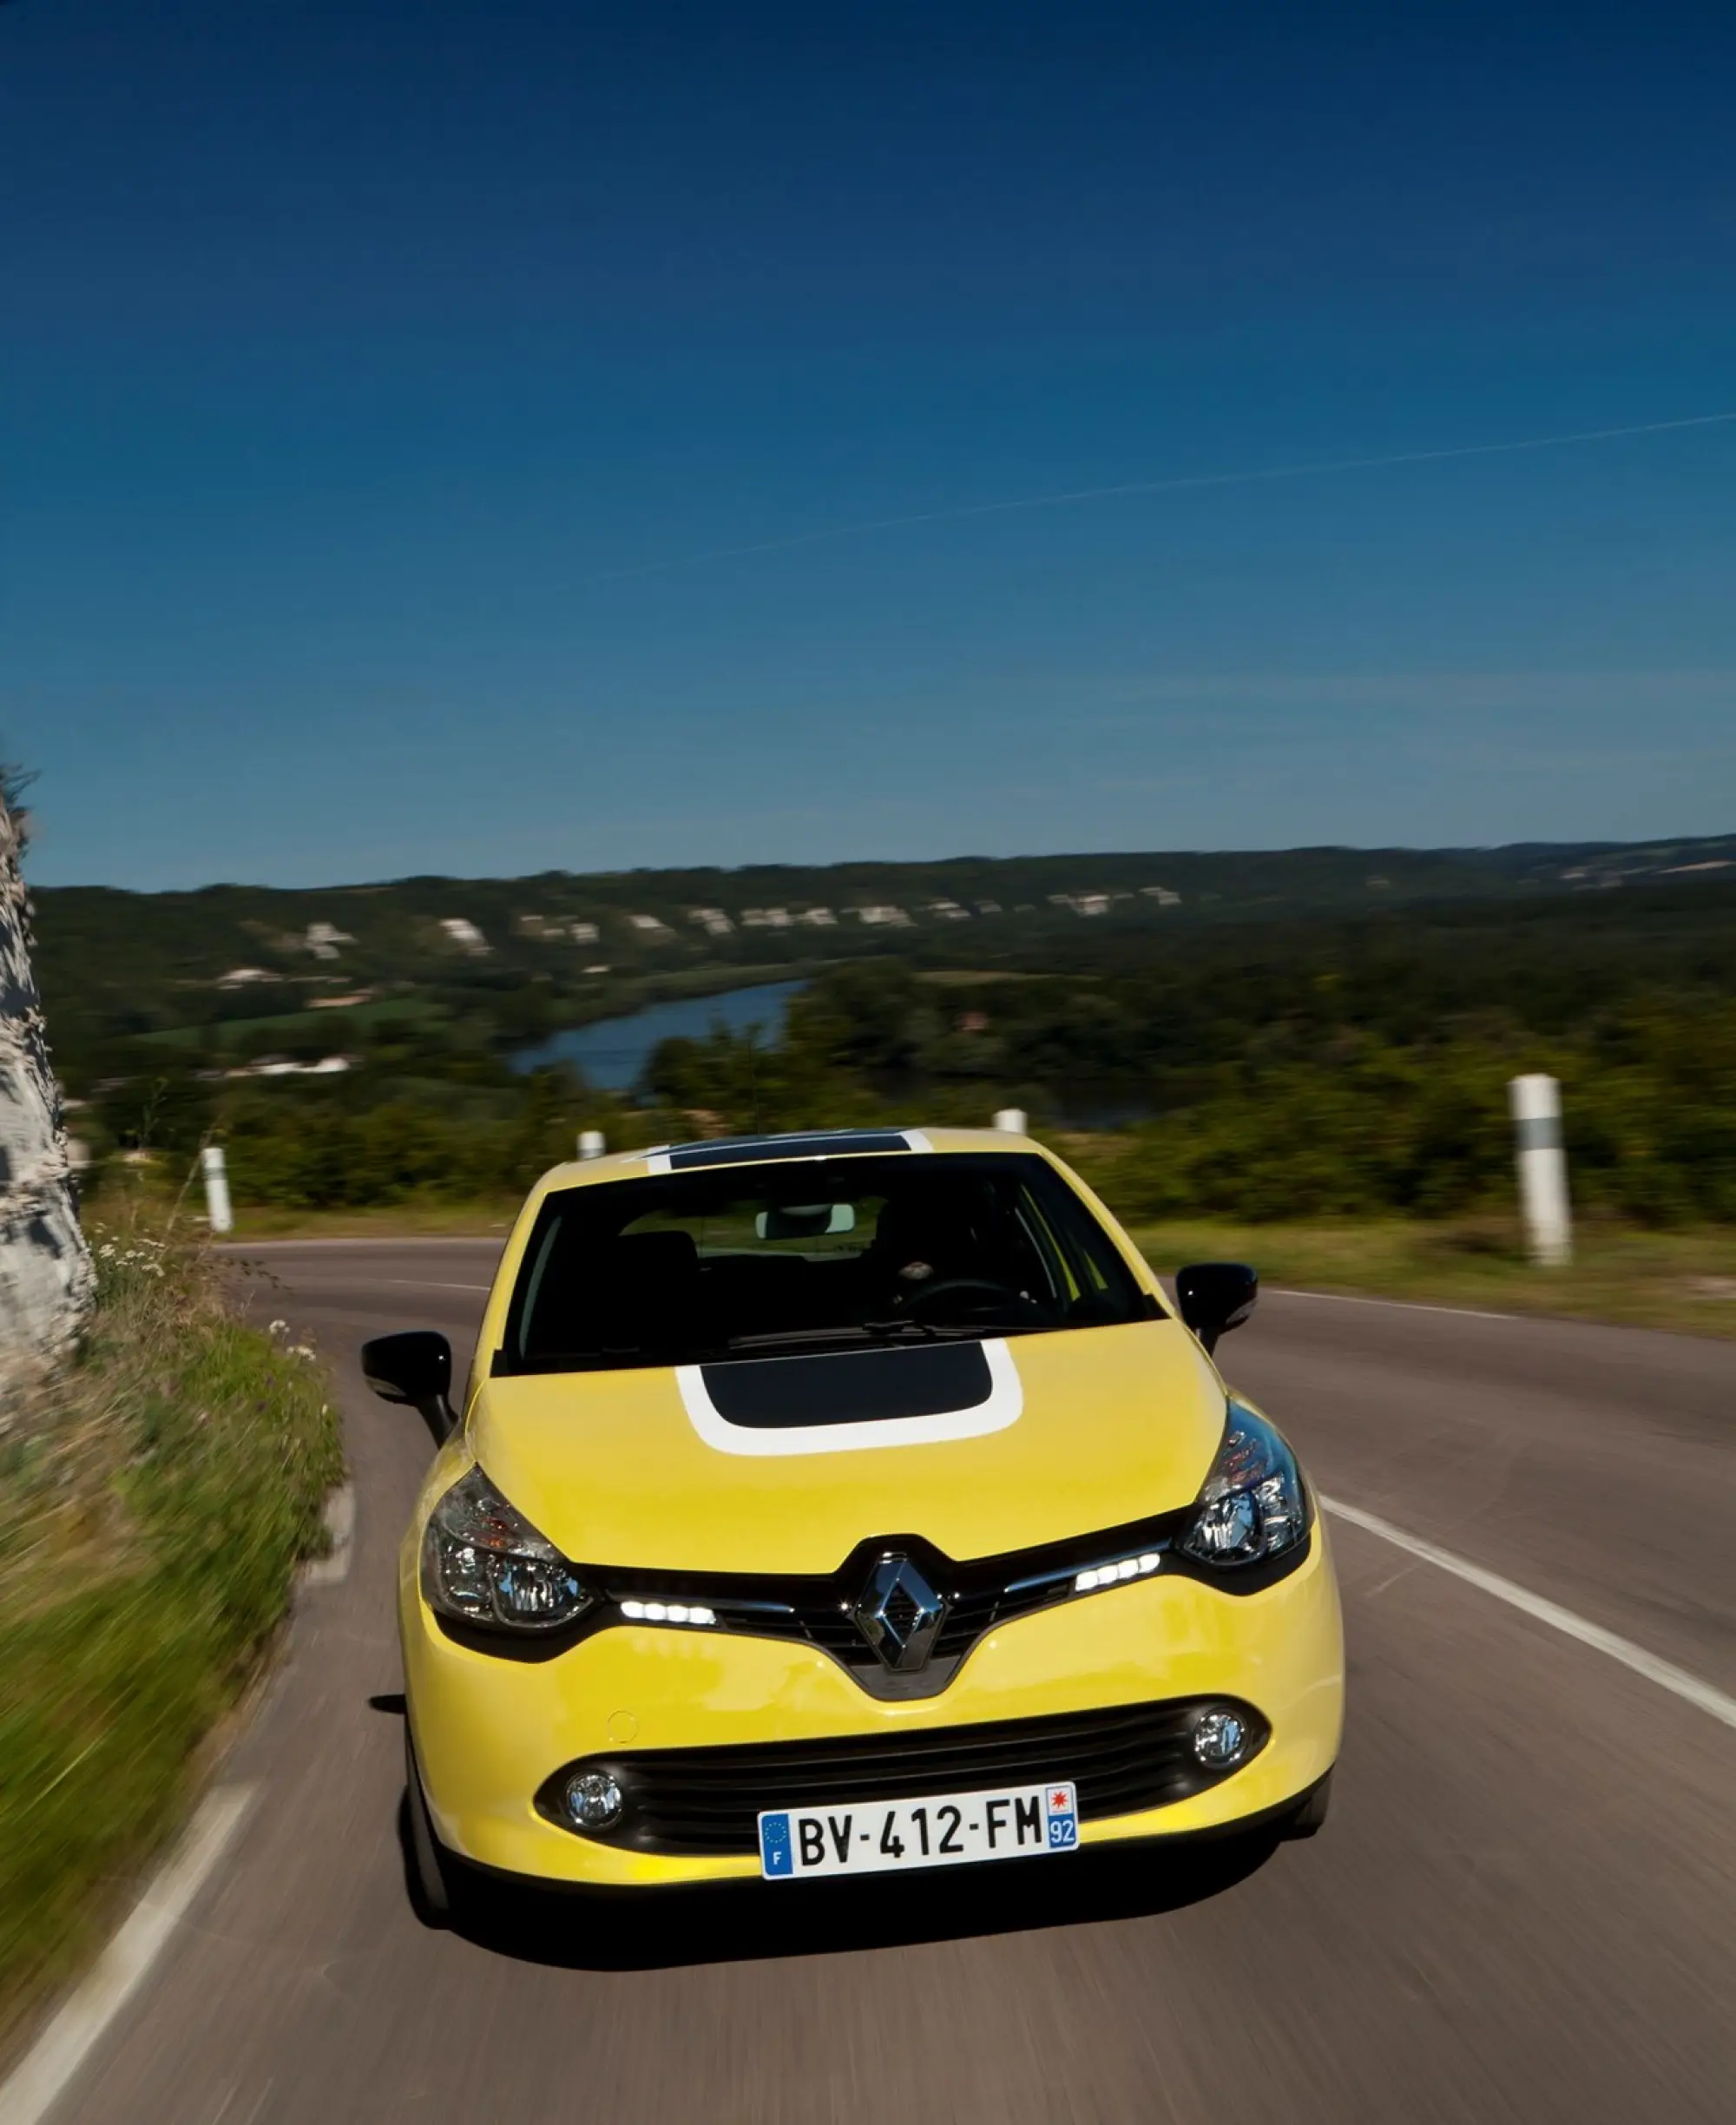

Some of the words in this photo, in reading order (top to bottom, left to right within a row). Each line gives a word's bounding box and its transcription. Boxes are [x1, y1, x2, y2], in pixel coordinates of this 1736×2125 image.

[798, 1795, 1042, 1866] BV-412-FM
[1050, 1820, 1075, 1845] 92
[773, 1852, 782, 1865] F
